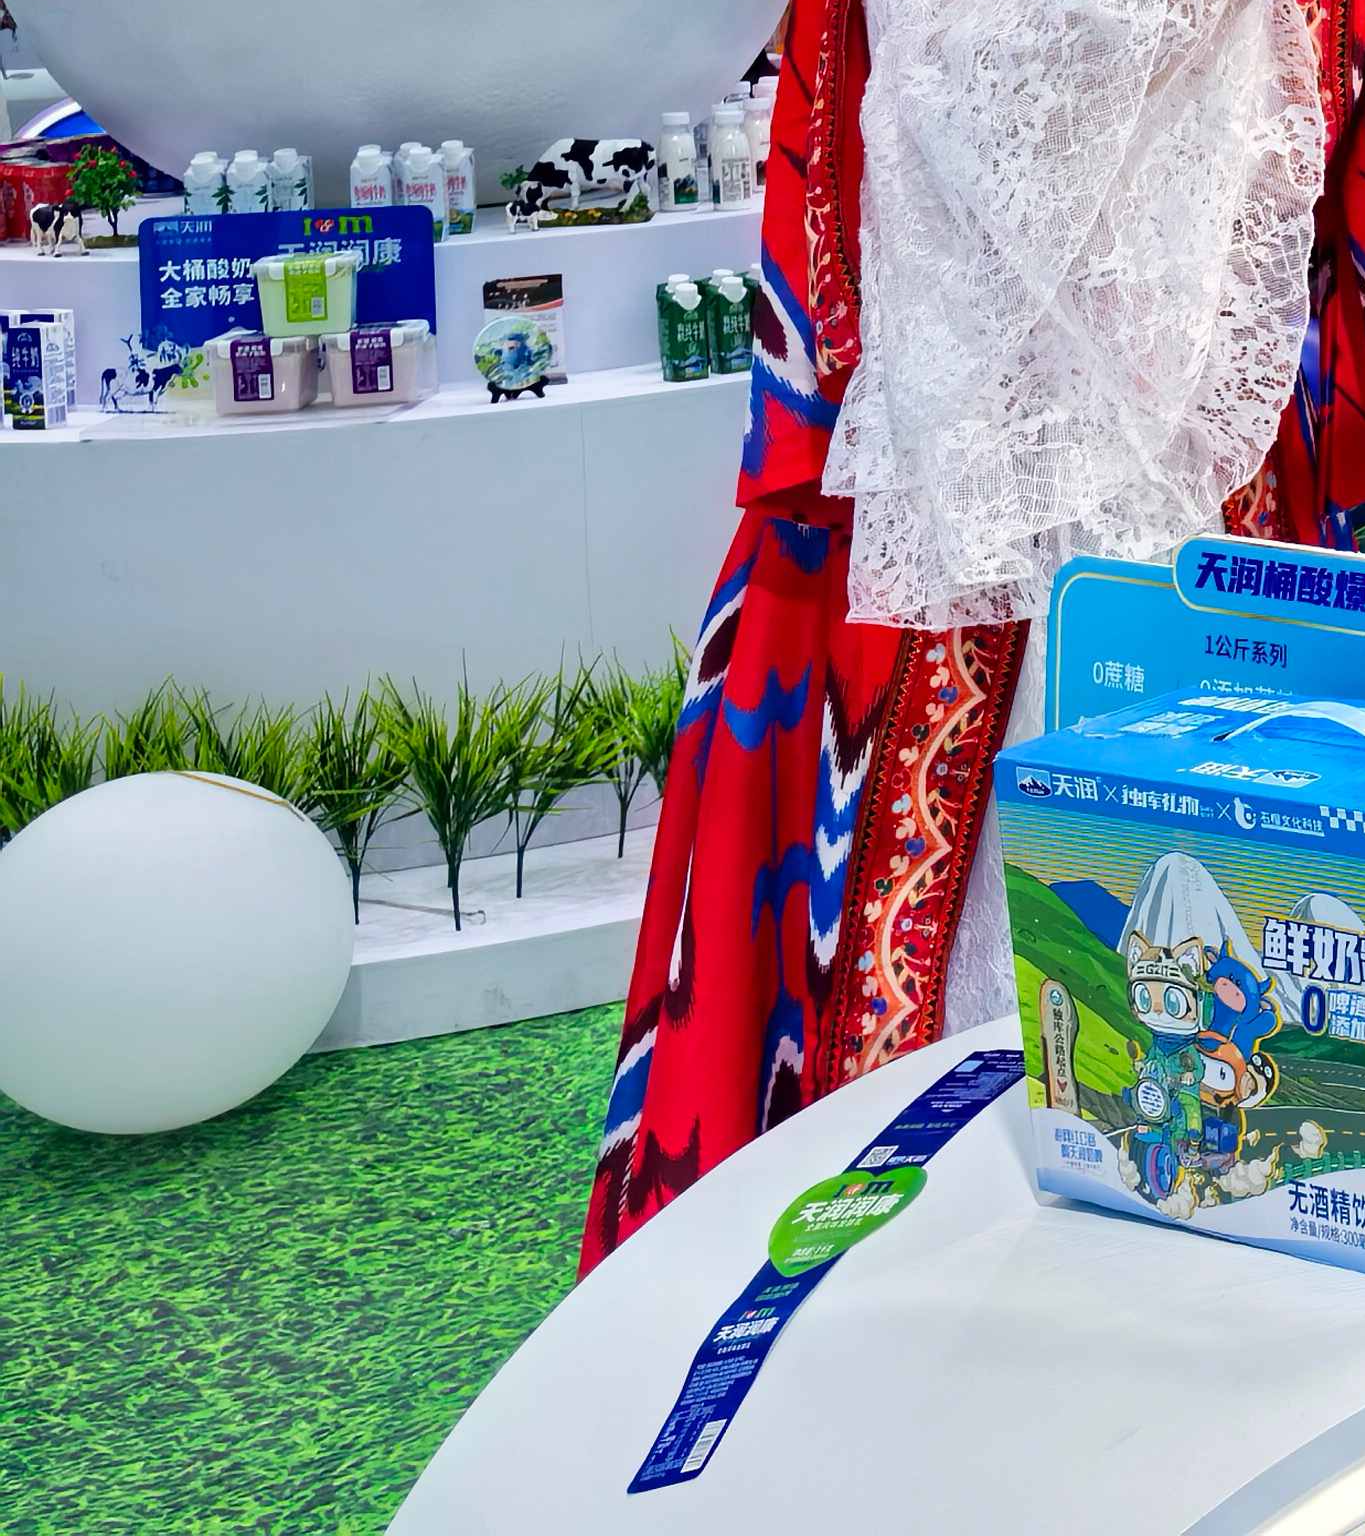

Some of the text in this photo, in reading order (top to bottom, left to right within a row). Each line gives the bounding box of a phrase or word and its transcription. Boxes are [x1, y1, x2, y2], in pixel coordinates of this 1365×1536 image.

[158, 258, 254, 283] 大桶酸奶
[160, 283, 255, 309] 全家畅享
[1204, 634, 1288, 669] 1公斤系列
[1092, 661, 1146, 693] 0蔗糖
[1053, 775, 1099, 801] 天润
[1121, 784, 1200, 817] 独库礼物
[1301, 985, 1326, 1034] 0
